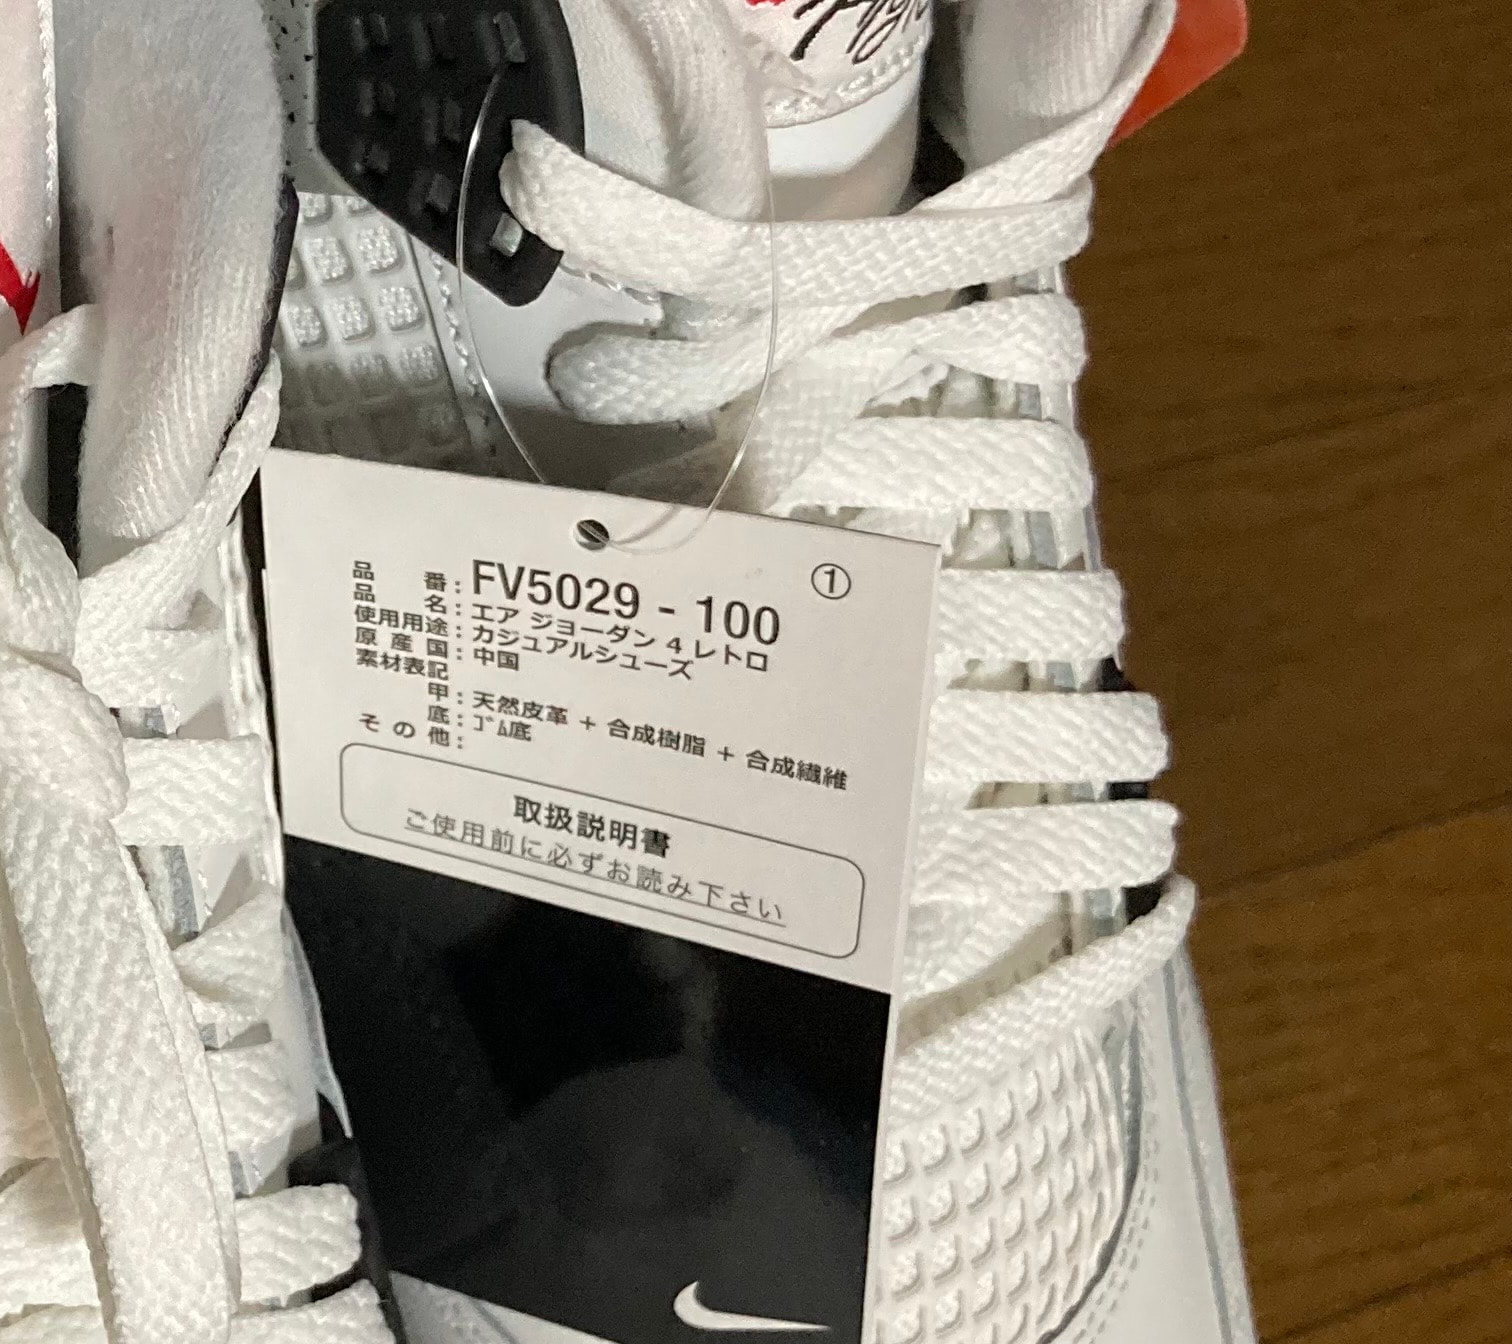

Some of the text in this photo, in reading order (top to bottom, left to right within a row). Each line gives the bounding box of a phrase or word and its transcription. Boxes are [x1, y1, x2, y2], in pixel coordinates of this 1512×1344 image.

[471, 558, 641, 620] FV5029
[695, 595, 781, 646] 100
[355, 648, 449, 681] 素材表記
[471, 624, 695, 681] カジュアルシューズ
[472, 647, 520, 672] 中国
[512, 794, 672, 859] 取扱説明書
[405, 807, 784, 922] ご使用前に必ずお読み下さい
